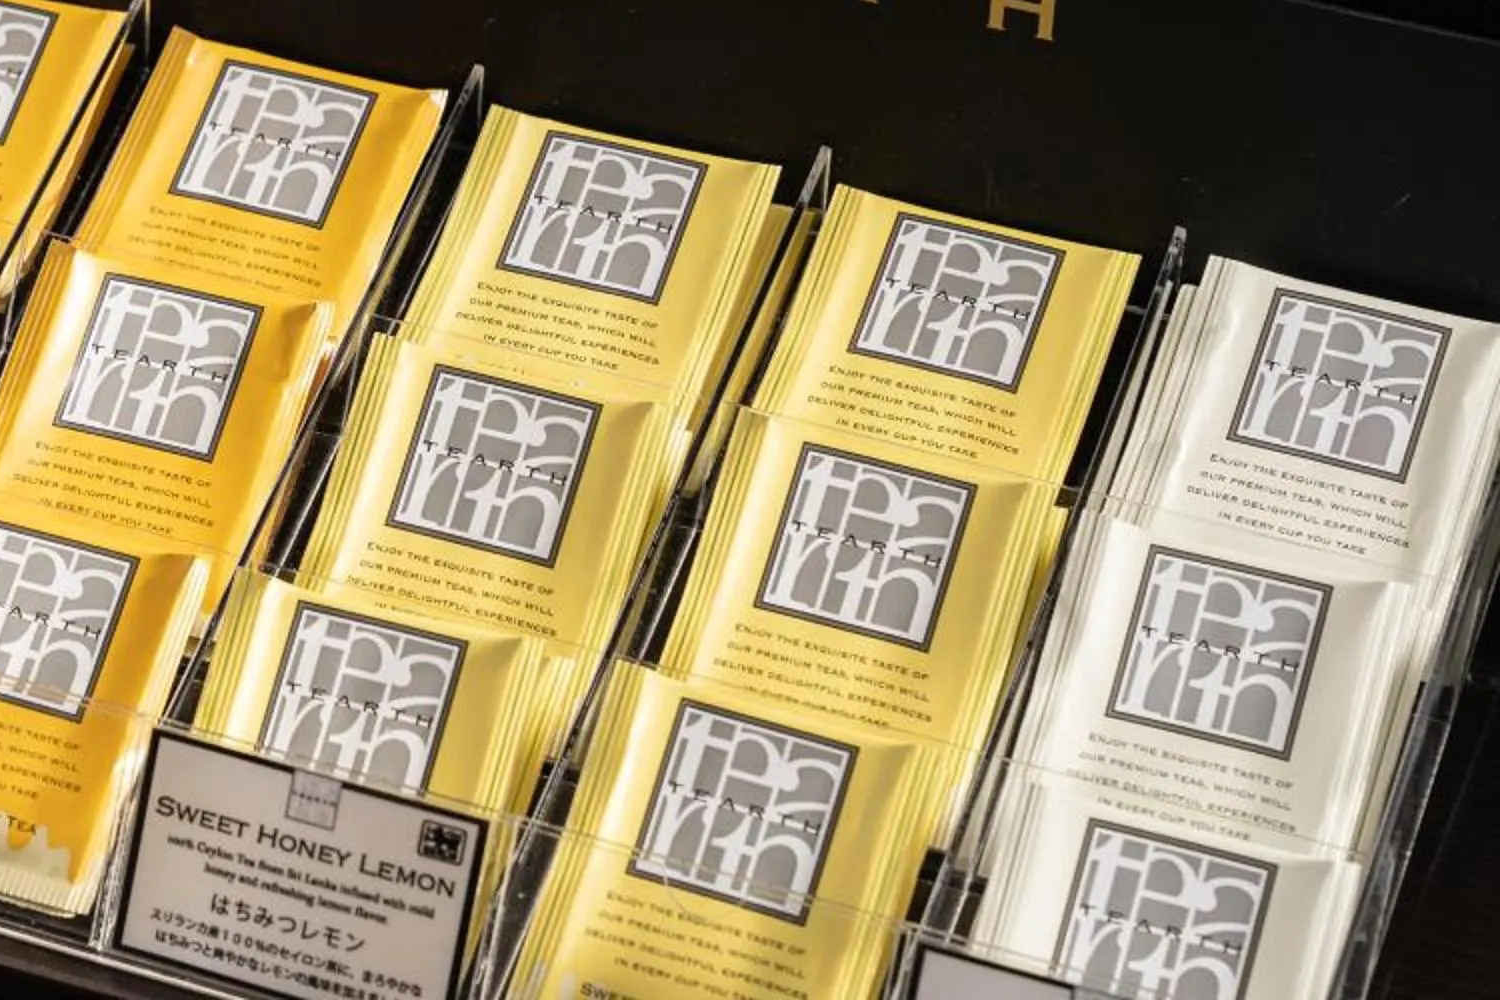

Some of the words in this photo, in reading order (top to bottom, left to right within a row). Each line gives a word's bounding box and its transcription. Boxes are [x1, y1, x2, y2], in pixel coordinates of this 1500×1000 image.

[532, 195, 674, 235] TEARTH
[883, 278, 1032, 322] TEARTH
[89, 344, 229, 385] TEARTH
[1263, 359, 1418, 406] TEARTH
[421, 440, 568, 487] TEARTH
[789, 519, 943, 569] TEARTH
[1140, 625, 1300, 674] TEARTH
[287, 682, 434, 727] TEARTH
[7, 815, 37, 835] TEA
[665, 780, 822, 836] TEARTH
[154, 793, 251, 840] SWEET
[255, 822, 353, 870] HONEY
[357, 852, 456, 899] LEMON
[195, 842, 234, 864] Ceylon
[237, 854, 255, 868] Tea
[257, 859, 285, 876] from
[286, 867, 302, 881] Sri
[303, 872, 337, 892] Lanka
[237, 873, 259, 888] and
[209, 891, 367, 956] はちみつレモン
